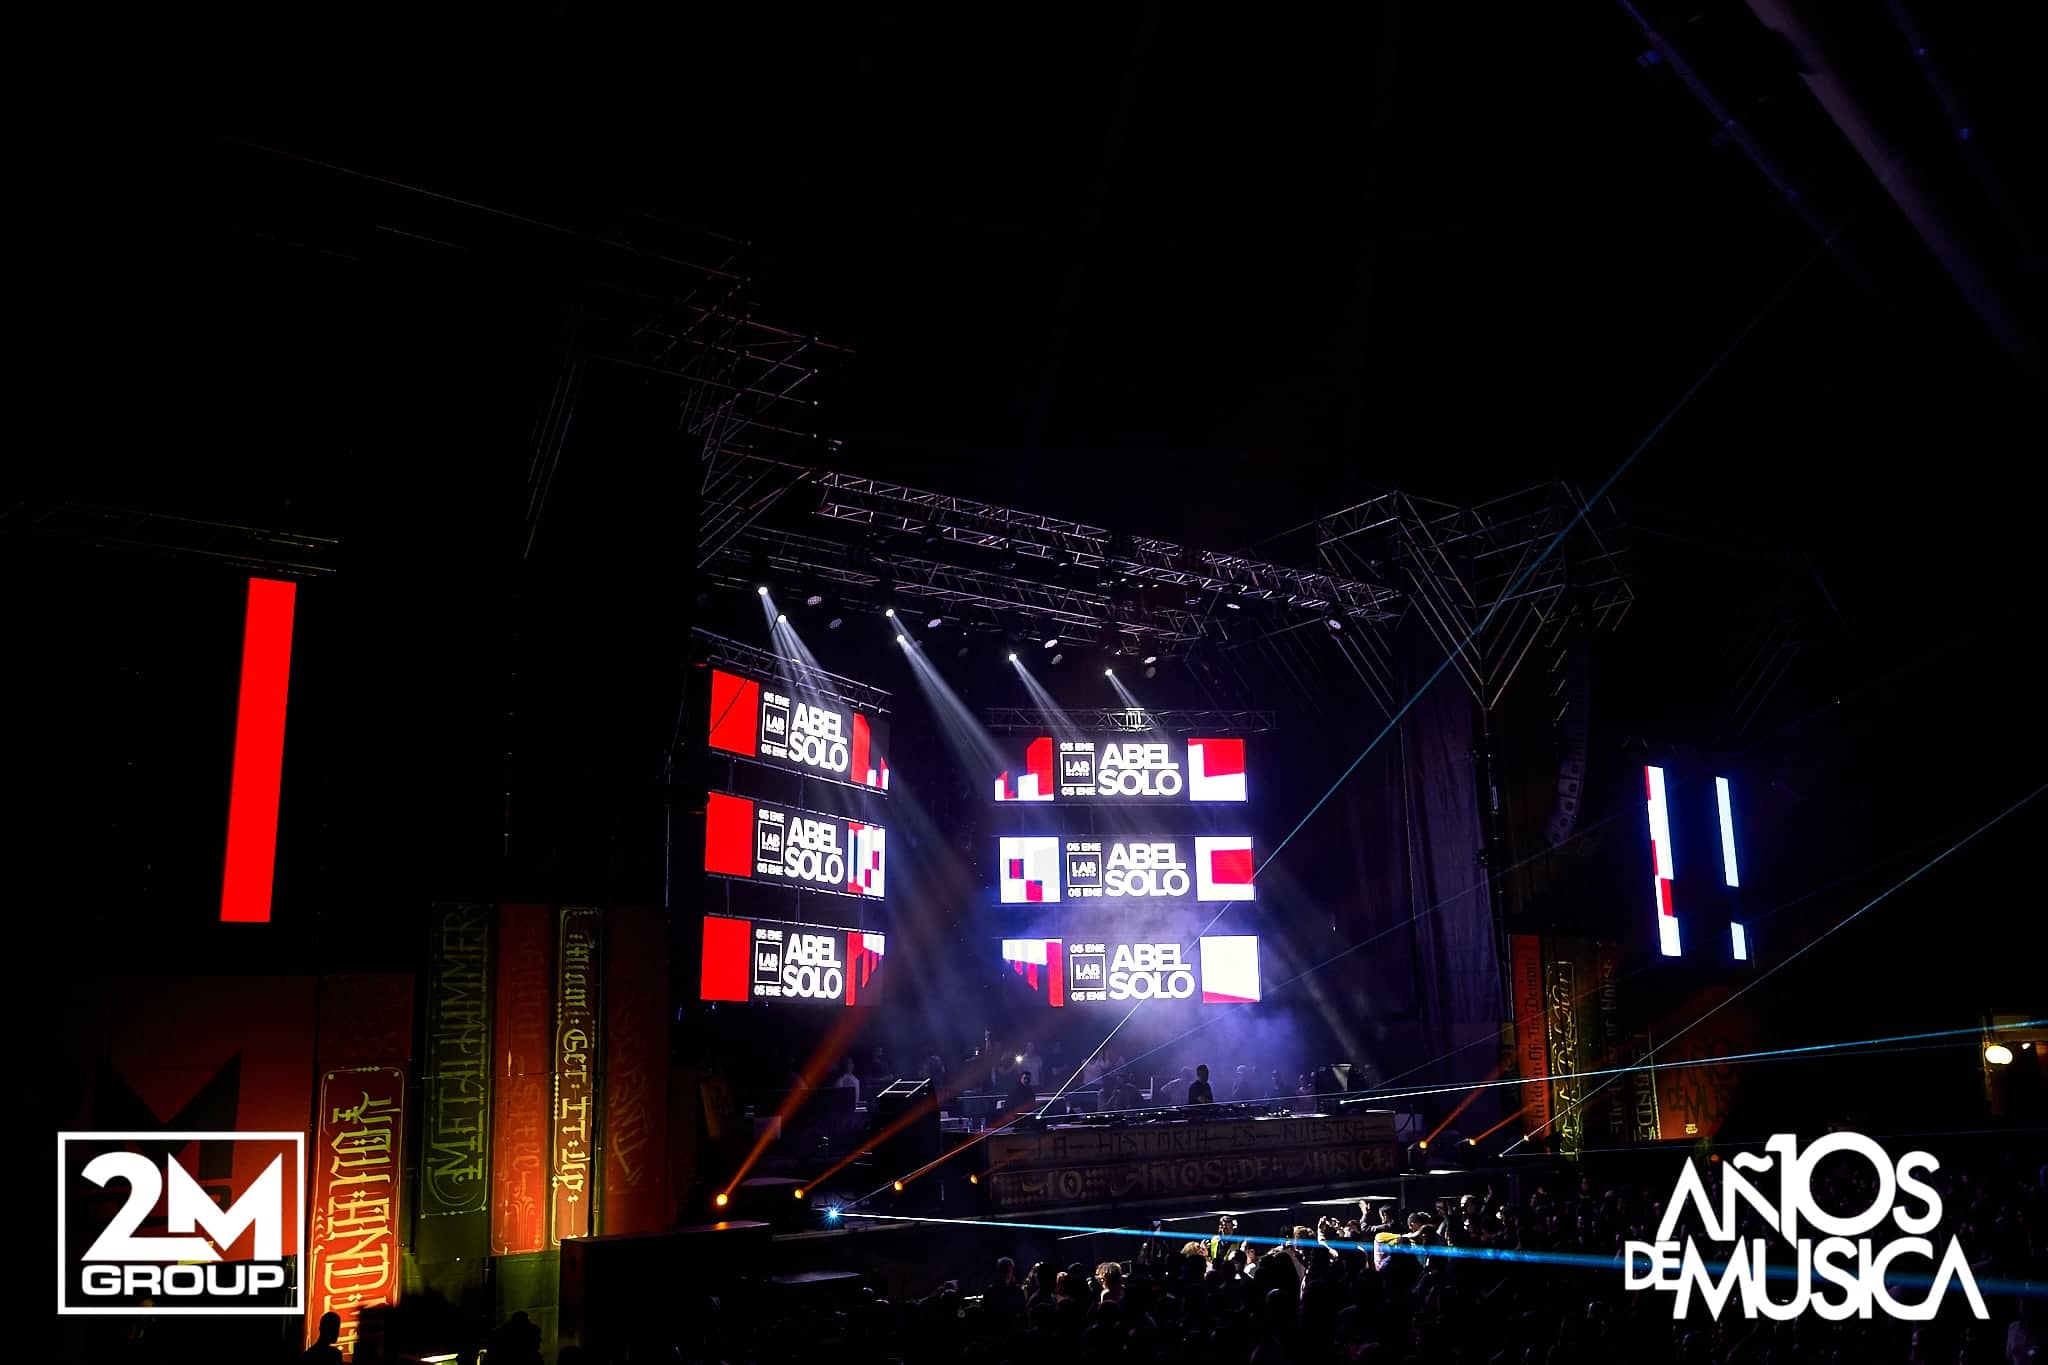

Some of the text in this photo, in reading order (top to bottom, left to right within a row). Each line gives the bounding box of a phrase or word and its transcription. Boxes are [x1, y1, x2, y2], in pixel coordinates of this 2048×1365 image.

[766, 714, 785, 730] LAB
[791, 703, 847, 744] ABEL
[788, 732, 848, 772] SOLO
[1099, 743, 1179, 770] ABEL
[1065, 760, 1090, 773] LAB
[1098, 769, 1183, 796] SOLO
[761, 832, 781, 848] LAB
[787, 817, 843, 855] ABEL
[784, 846, 844, 885] SOLO
[1071, 861, 1096, 874] LAB
[1106, 843, 1187, 870] ABEL
[1104, 869, 1190, 897] SOLO
[759, 953, 778, 968] LAB
[784, 933, 842, 968] ABEL
[1111, 943, 1192, 972] ABEL
[782, 965, 843, 999] SOLO
[1076, 963, 1101, 976] LAB
[1109, 971, 1196, 1000] SOLO
